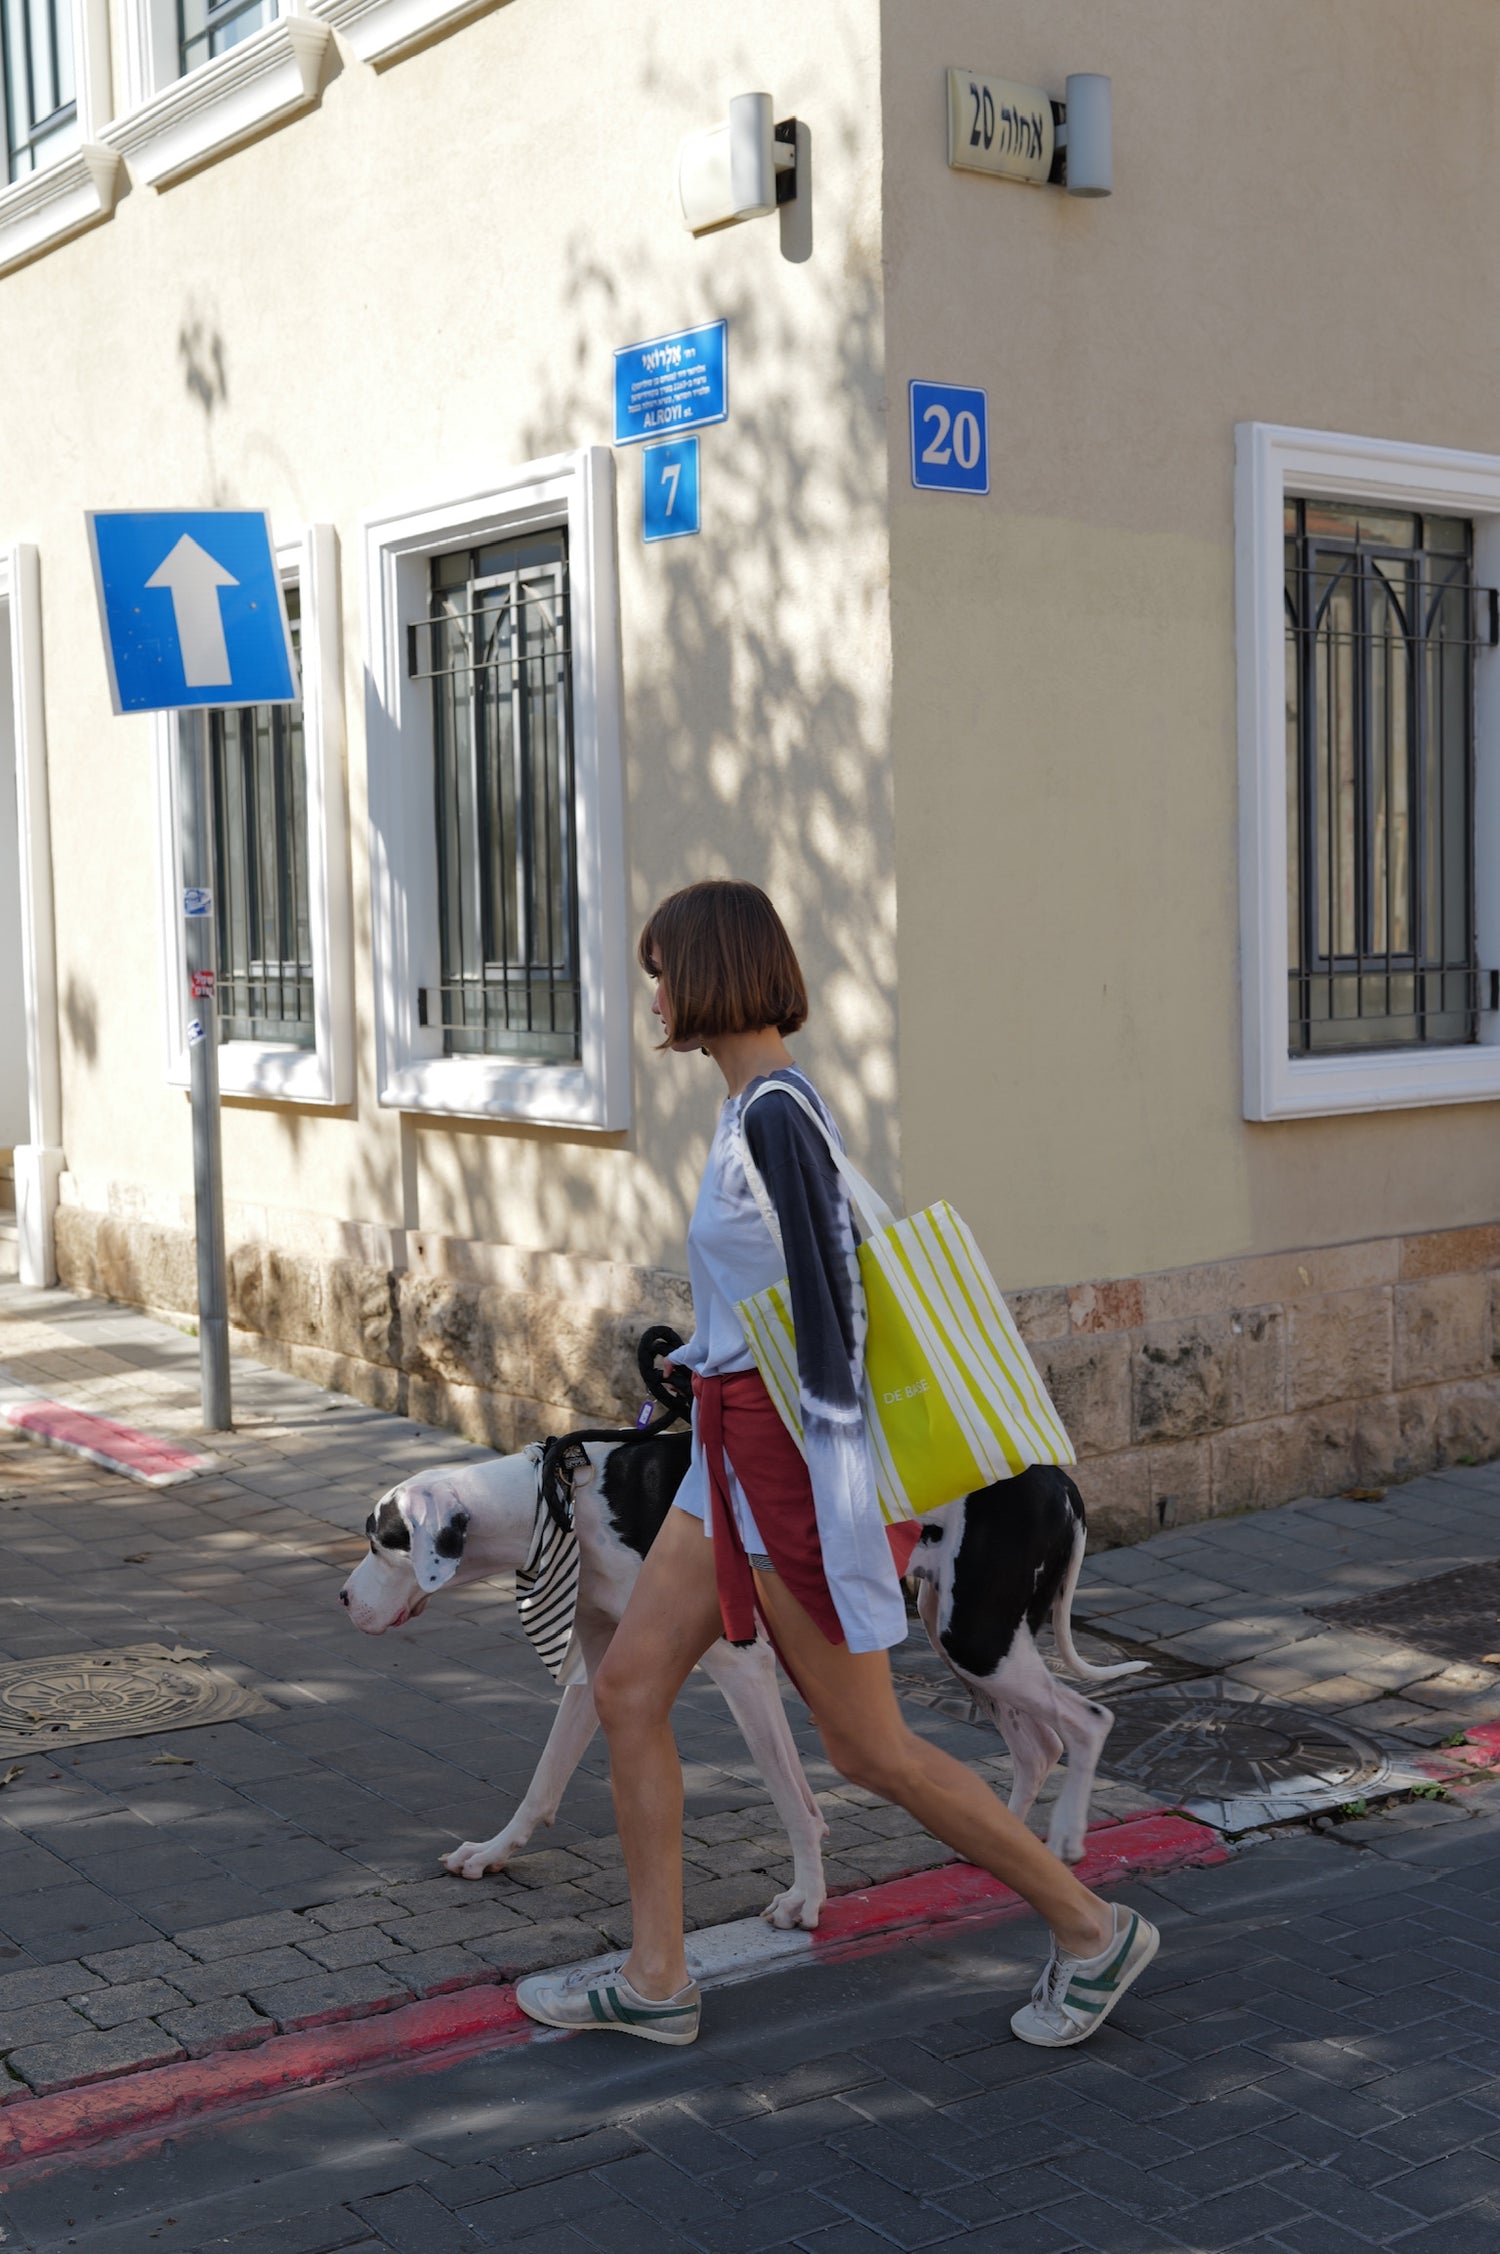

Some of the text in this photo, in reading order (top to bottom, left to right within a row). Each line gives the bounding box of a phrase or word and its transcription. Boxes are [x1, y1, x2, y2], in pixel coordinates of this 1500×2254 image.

[970, 82, 995, 151] 20
[643, 404, 682, 428] ALROYI
[922, 404, 981, 470] 20
[661, 464, 681, 516] 7
[883, 1388, 903, 1405] DE
